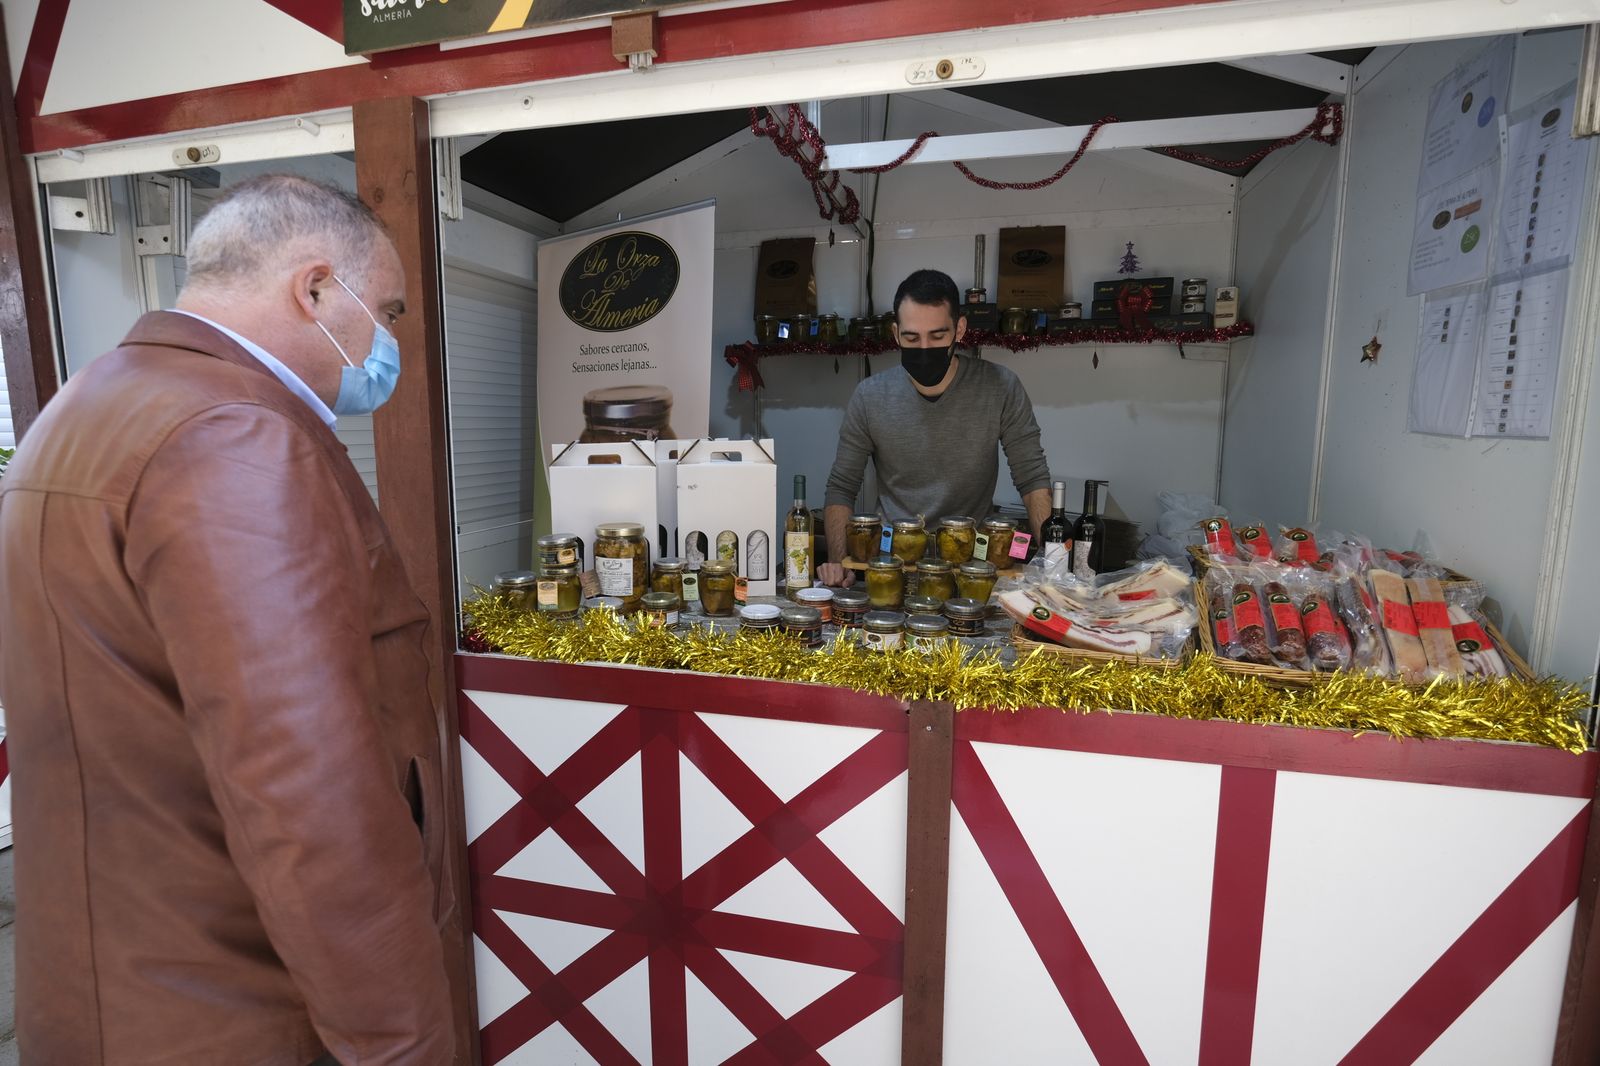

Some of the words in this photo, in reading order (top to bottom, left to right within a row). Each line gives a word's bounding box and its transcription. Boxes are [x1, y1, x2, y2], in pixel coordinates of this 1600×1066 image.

[373, 9, 413, 23] ALMERÍA
[579, 243, 609, 279] La
[617, 237, 662, 272] Orza
[579, 343, 610, 356] Sabores
[611, 341, 650, 354] cercanos,
[572, 360, 619, 373] Sensaciones
[620, 359, 657, 374] lejanas...
